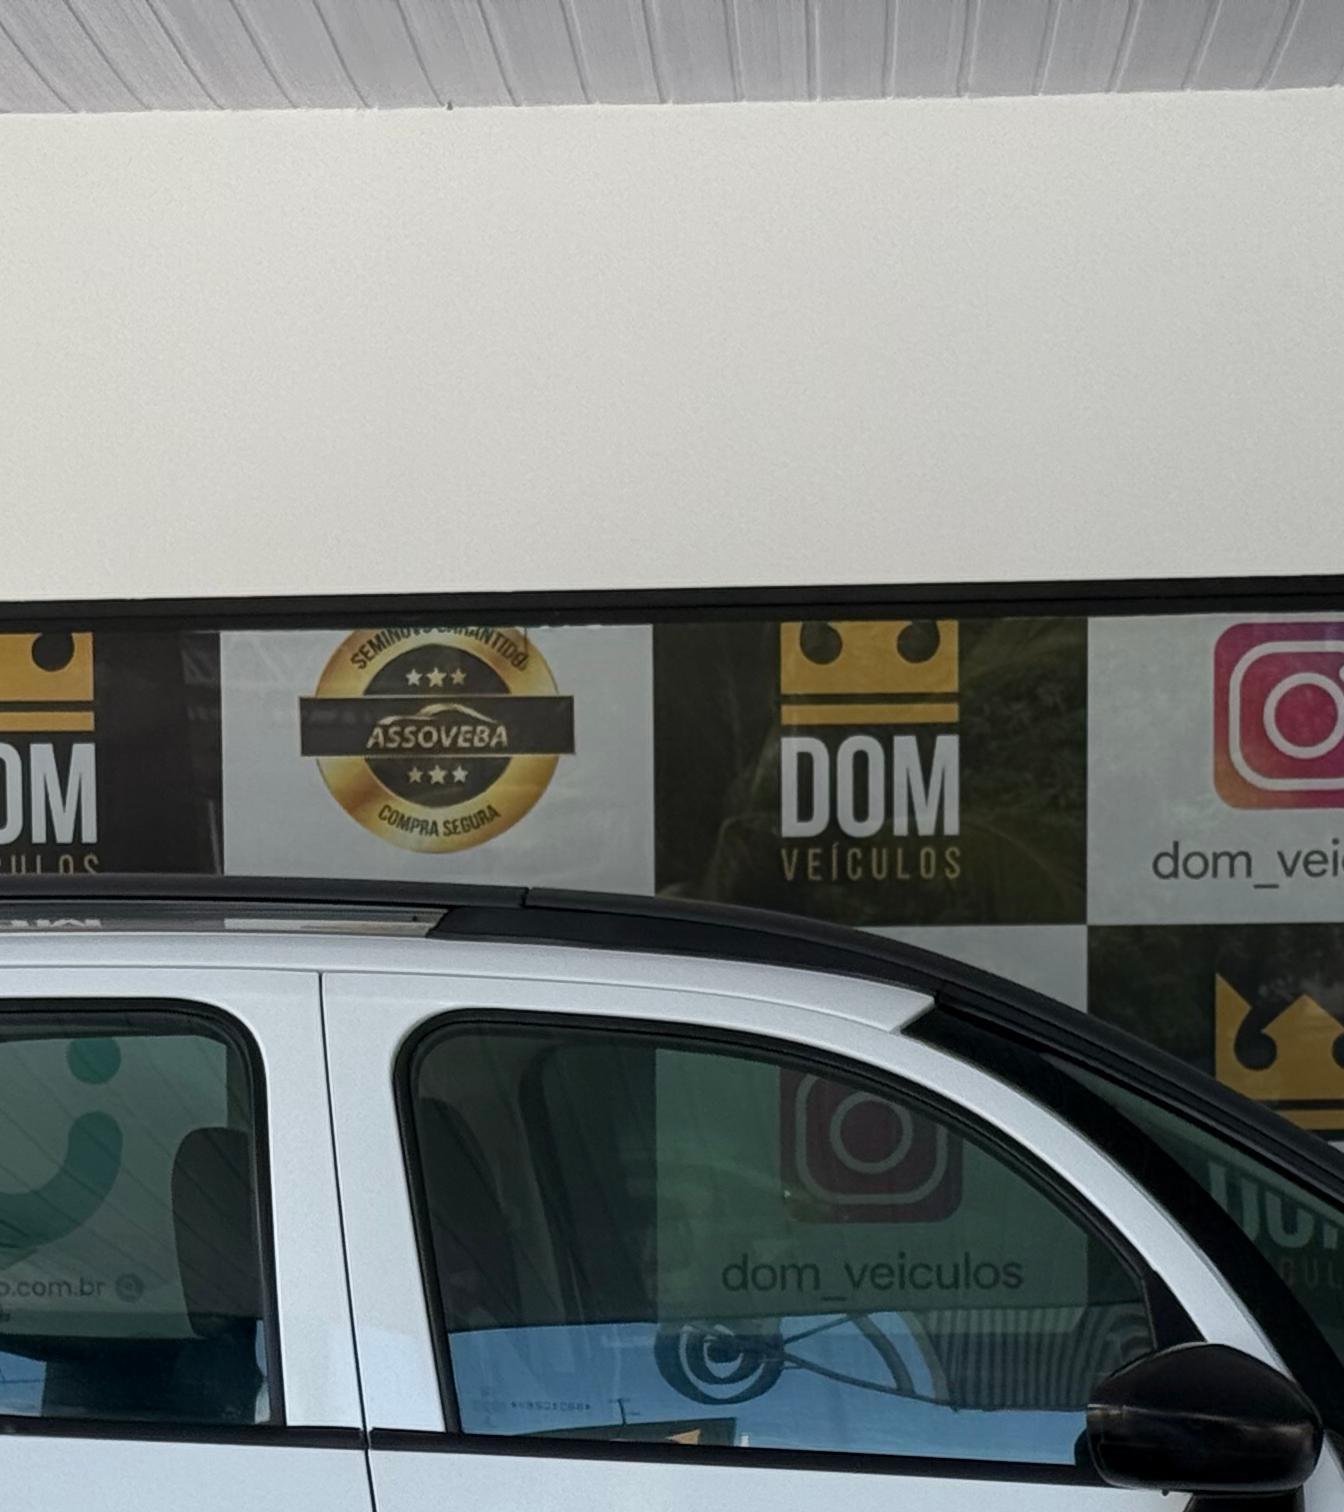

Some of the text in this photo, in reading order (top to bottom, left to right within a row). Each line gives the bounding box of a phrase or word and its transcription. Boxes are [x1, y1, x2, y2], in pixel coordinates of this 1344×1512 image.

[366, 724, 508, 749] ASSOVEBA
[781, 735, 960, 838] DOM
[378, 804, 501, 837] COMPRA SEGURA
[781, 842, 961, 881] VEÍCULOS
[720, 1252, 1025, 1301] dom_veiculos
